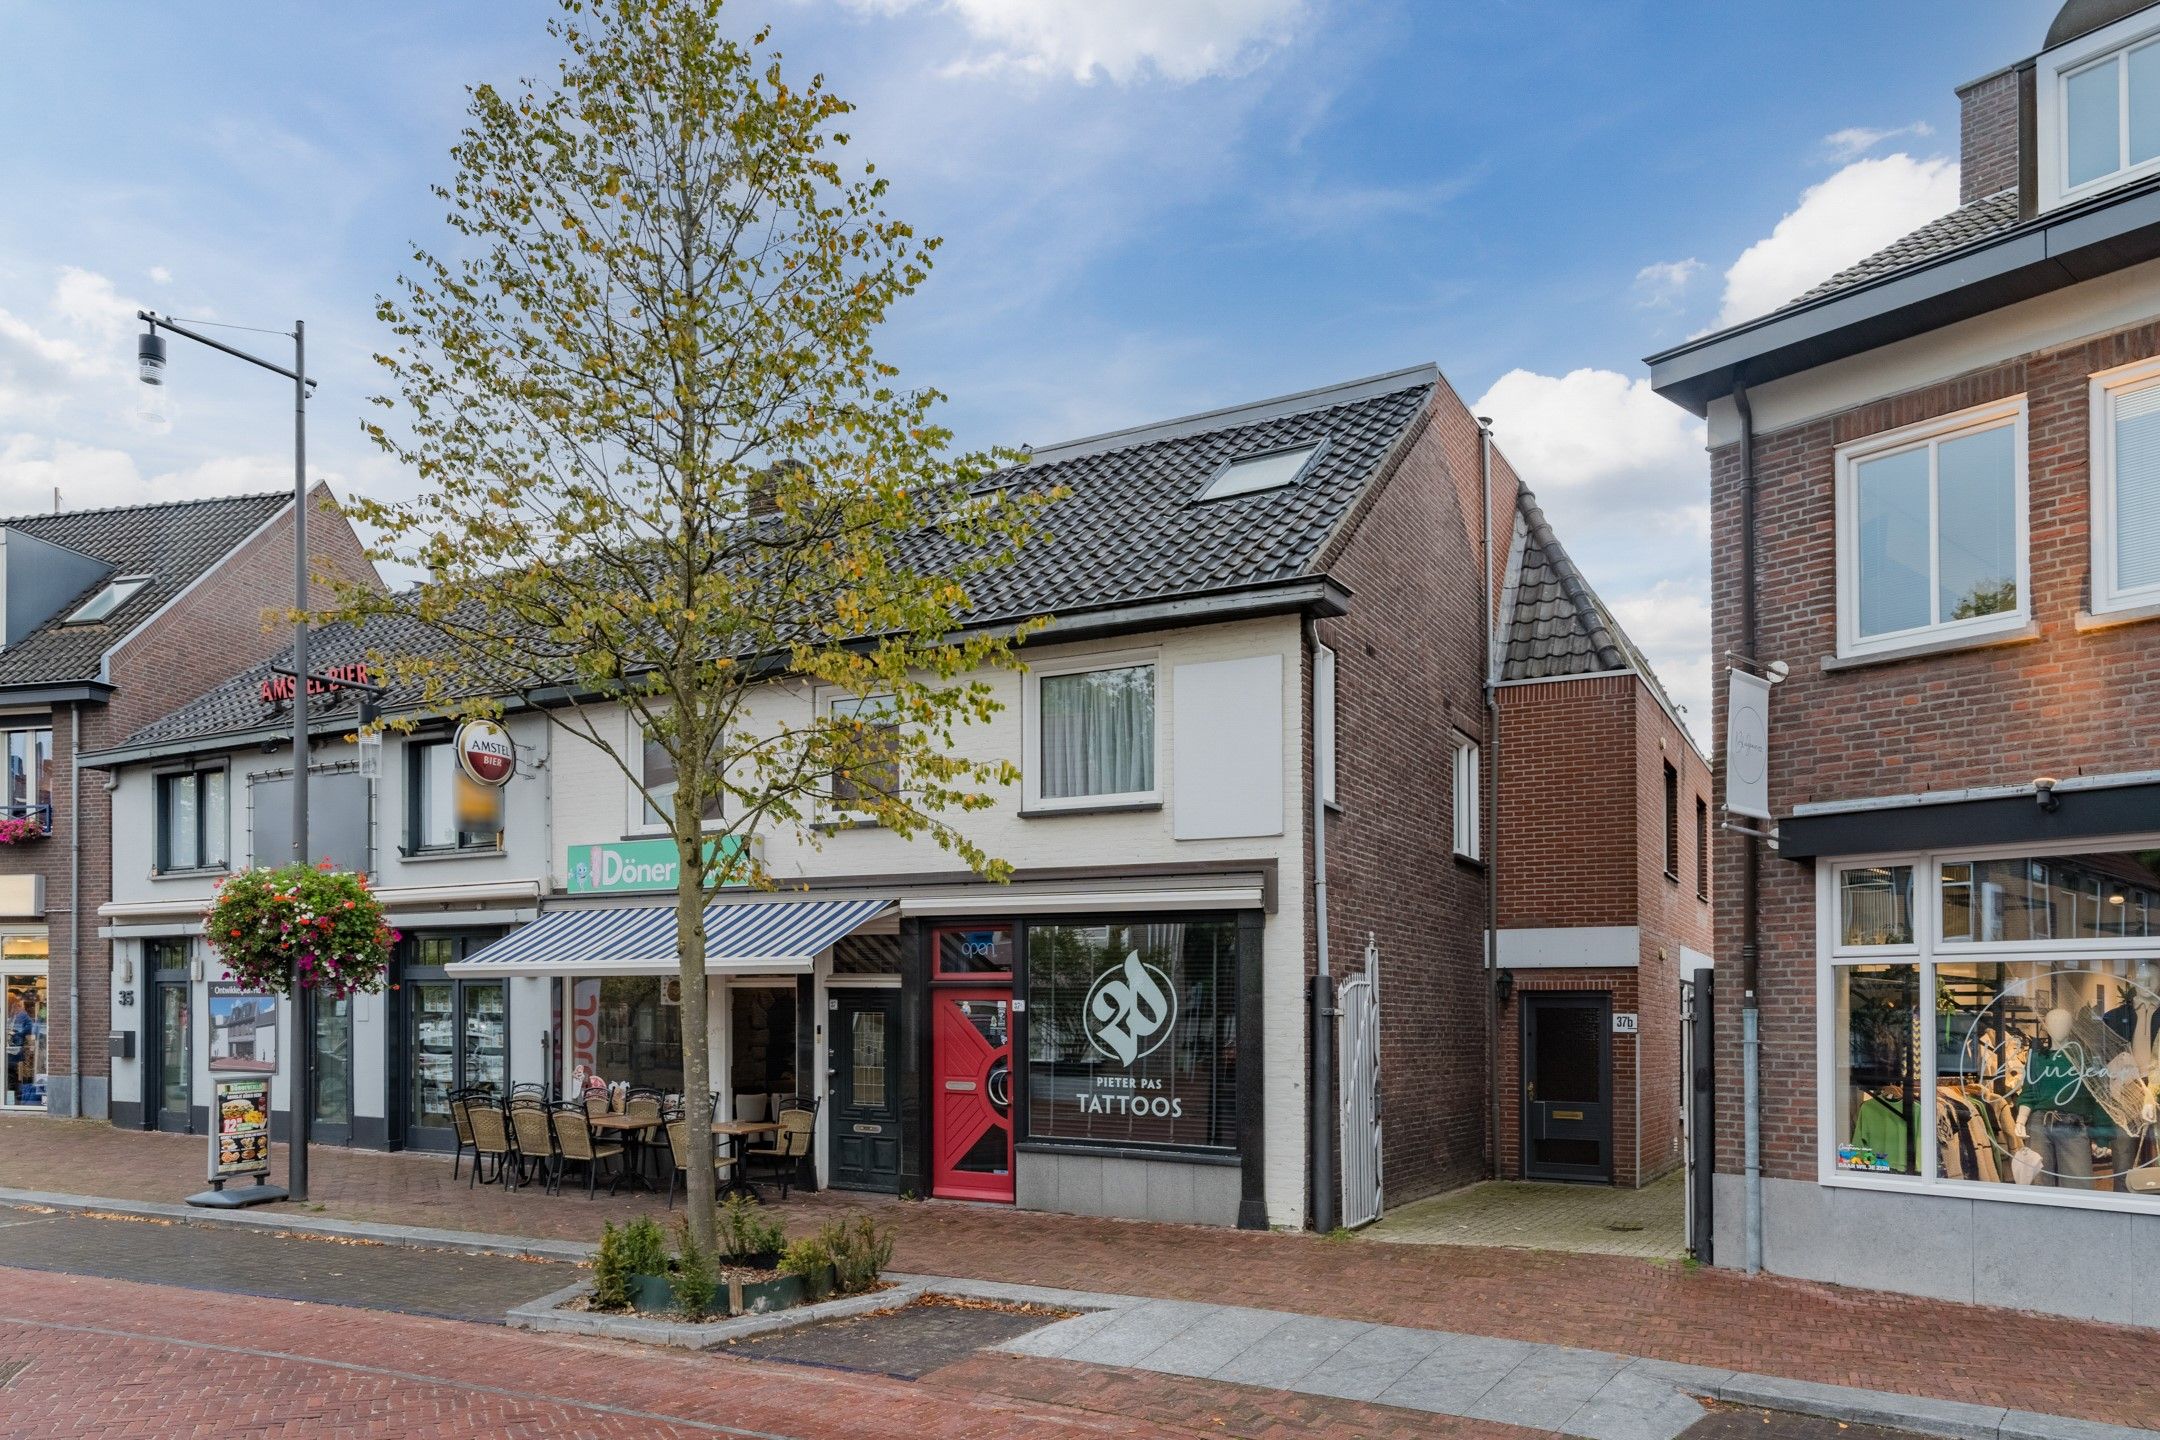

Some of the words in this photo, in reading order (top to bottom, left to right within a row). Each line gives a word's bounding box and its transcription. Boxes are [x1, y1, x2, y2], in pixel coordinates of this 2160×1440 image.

[261, 674, 325, 702] AMSEL
[328, 664, 368, 692] BIER
[471, 740, 511, 757] AMSTEL
[483, 755, 502, 767] BIER
[602, 850, 677, 887] Döner
[961, 942, 997, 959] open
[118, 990, 135, 1007] 35
[1616, 1016, 1634, 1028] 37b
[1096, 1076, 1137, 1089] PIETER
[1140, 1078, 1163, 1090] PAS
[1076, 1093, 1183, 1118] TATTOOS
